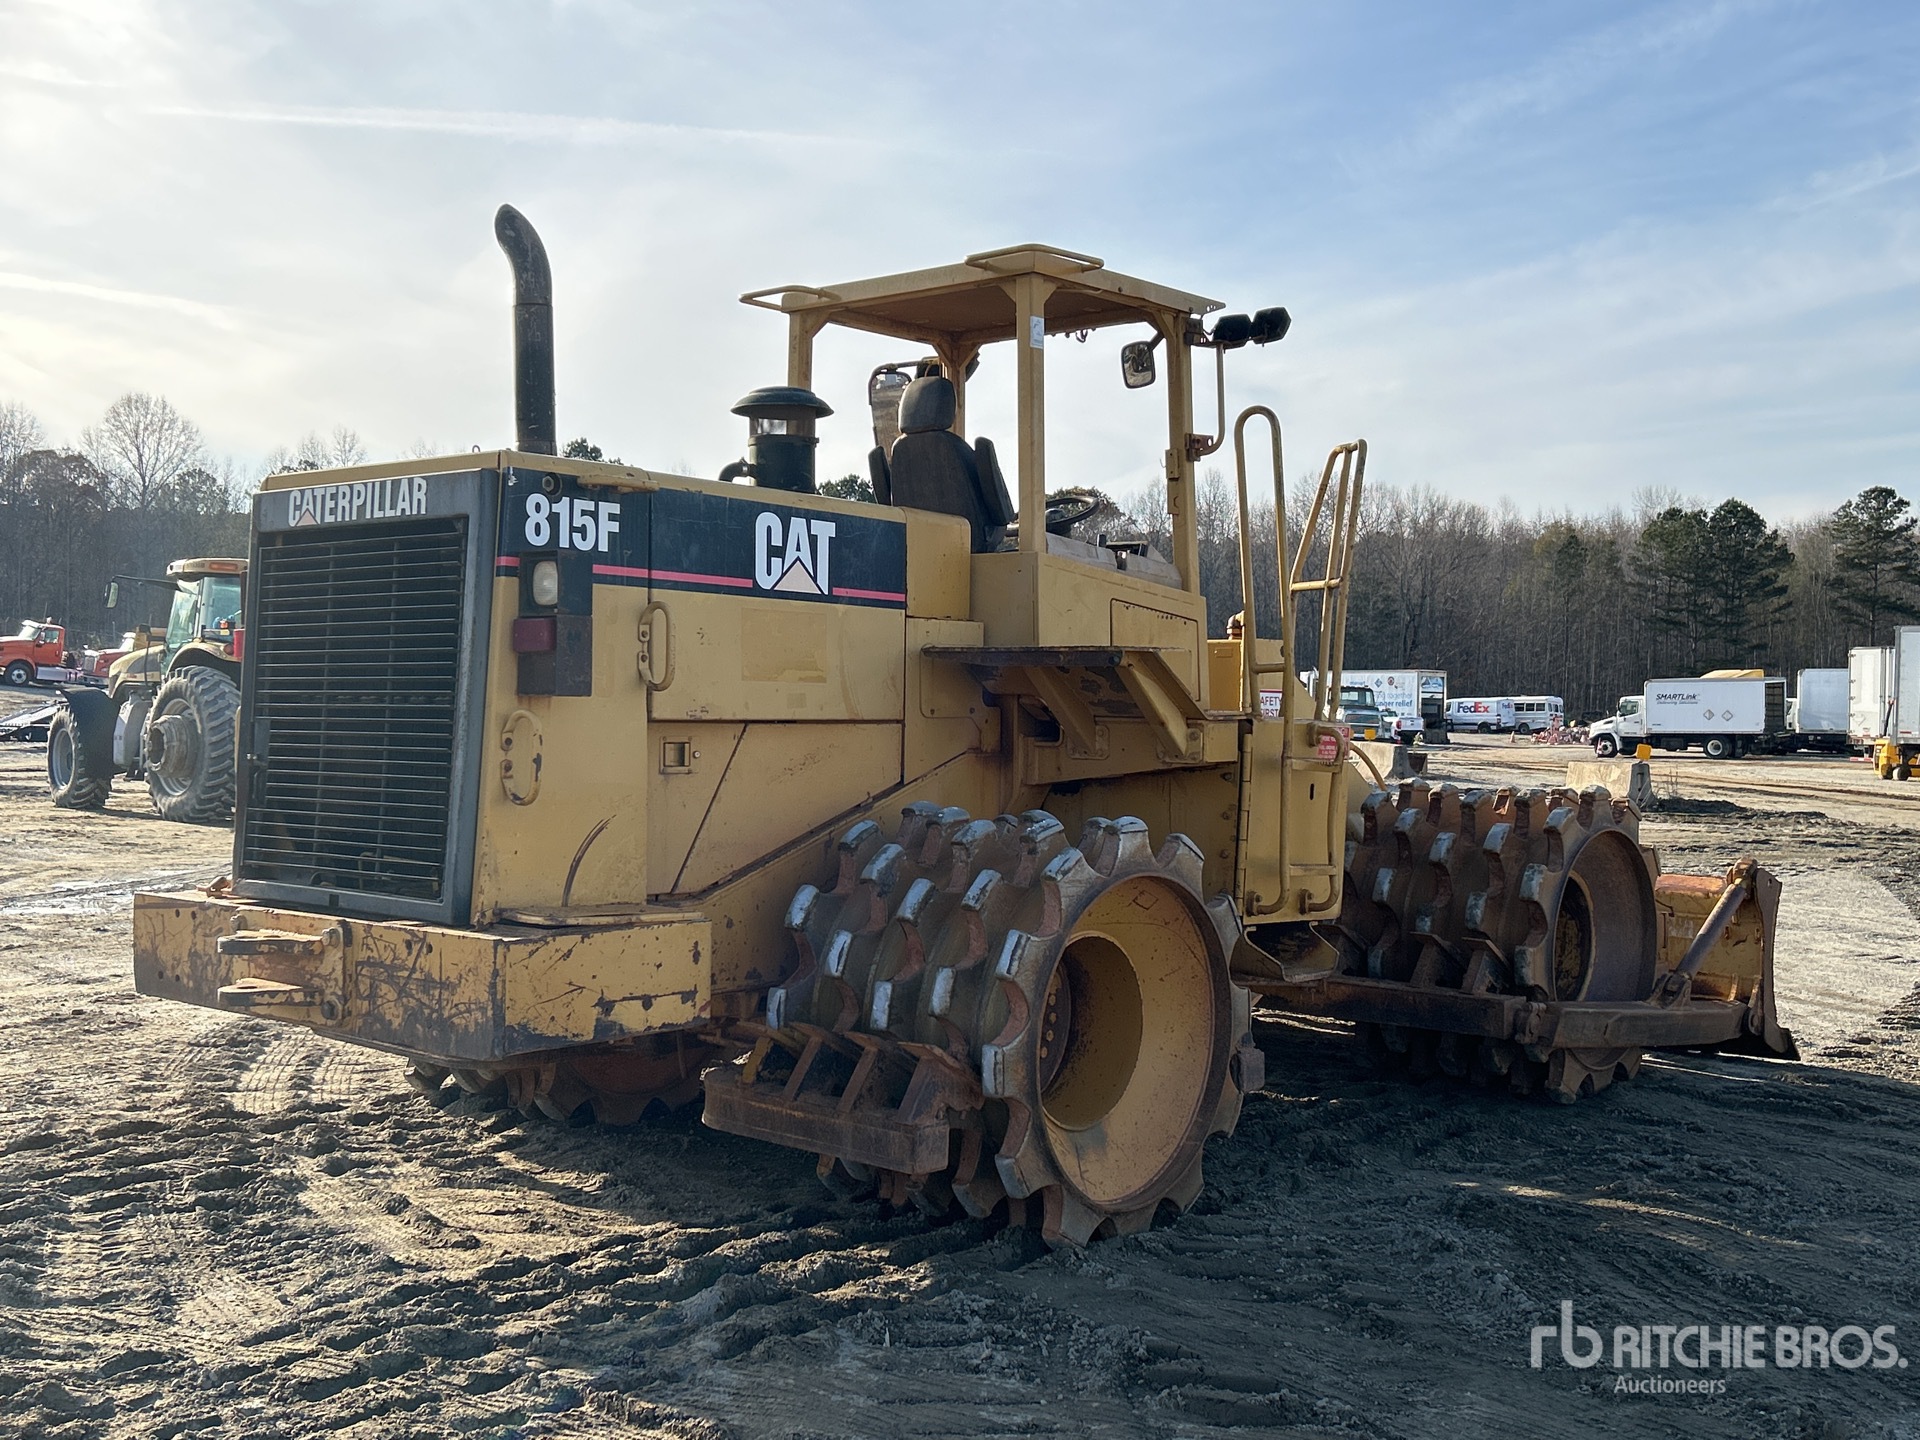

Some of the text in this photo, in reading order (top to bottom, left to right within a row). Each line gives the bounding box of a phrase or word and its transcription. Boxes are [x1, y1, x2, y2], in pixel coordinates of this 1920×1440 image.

[288, 477, 427, 527] CATERPILLAR
[525, 493, 620, 552] 815F
[755, 511, 836, 595] CAT
[1260, 696, 1282, 706] AFETY
[1457, 702, 1489, 713] FedEx
